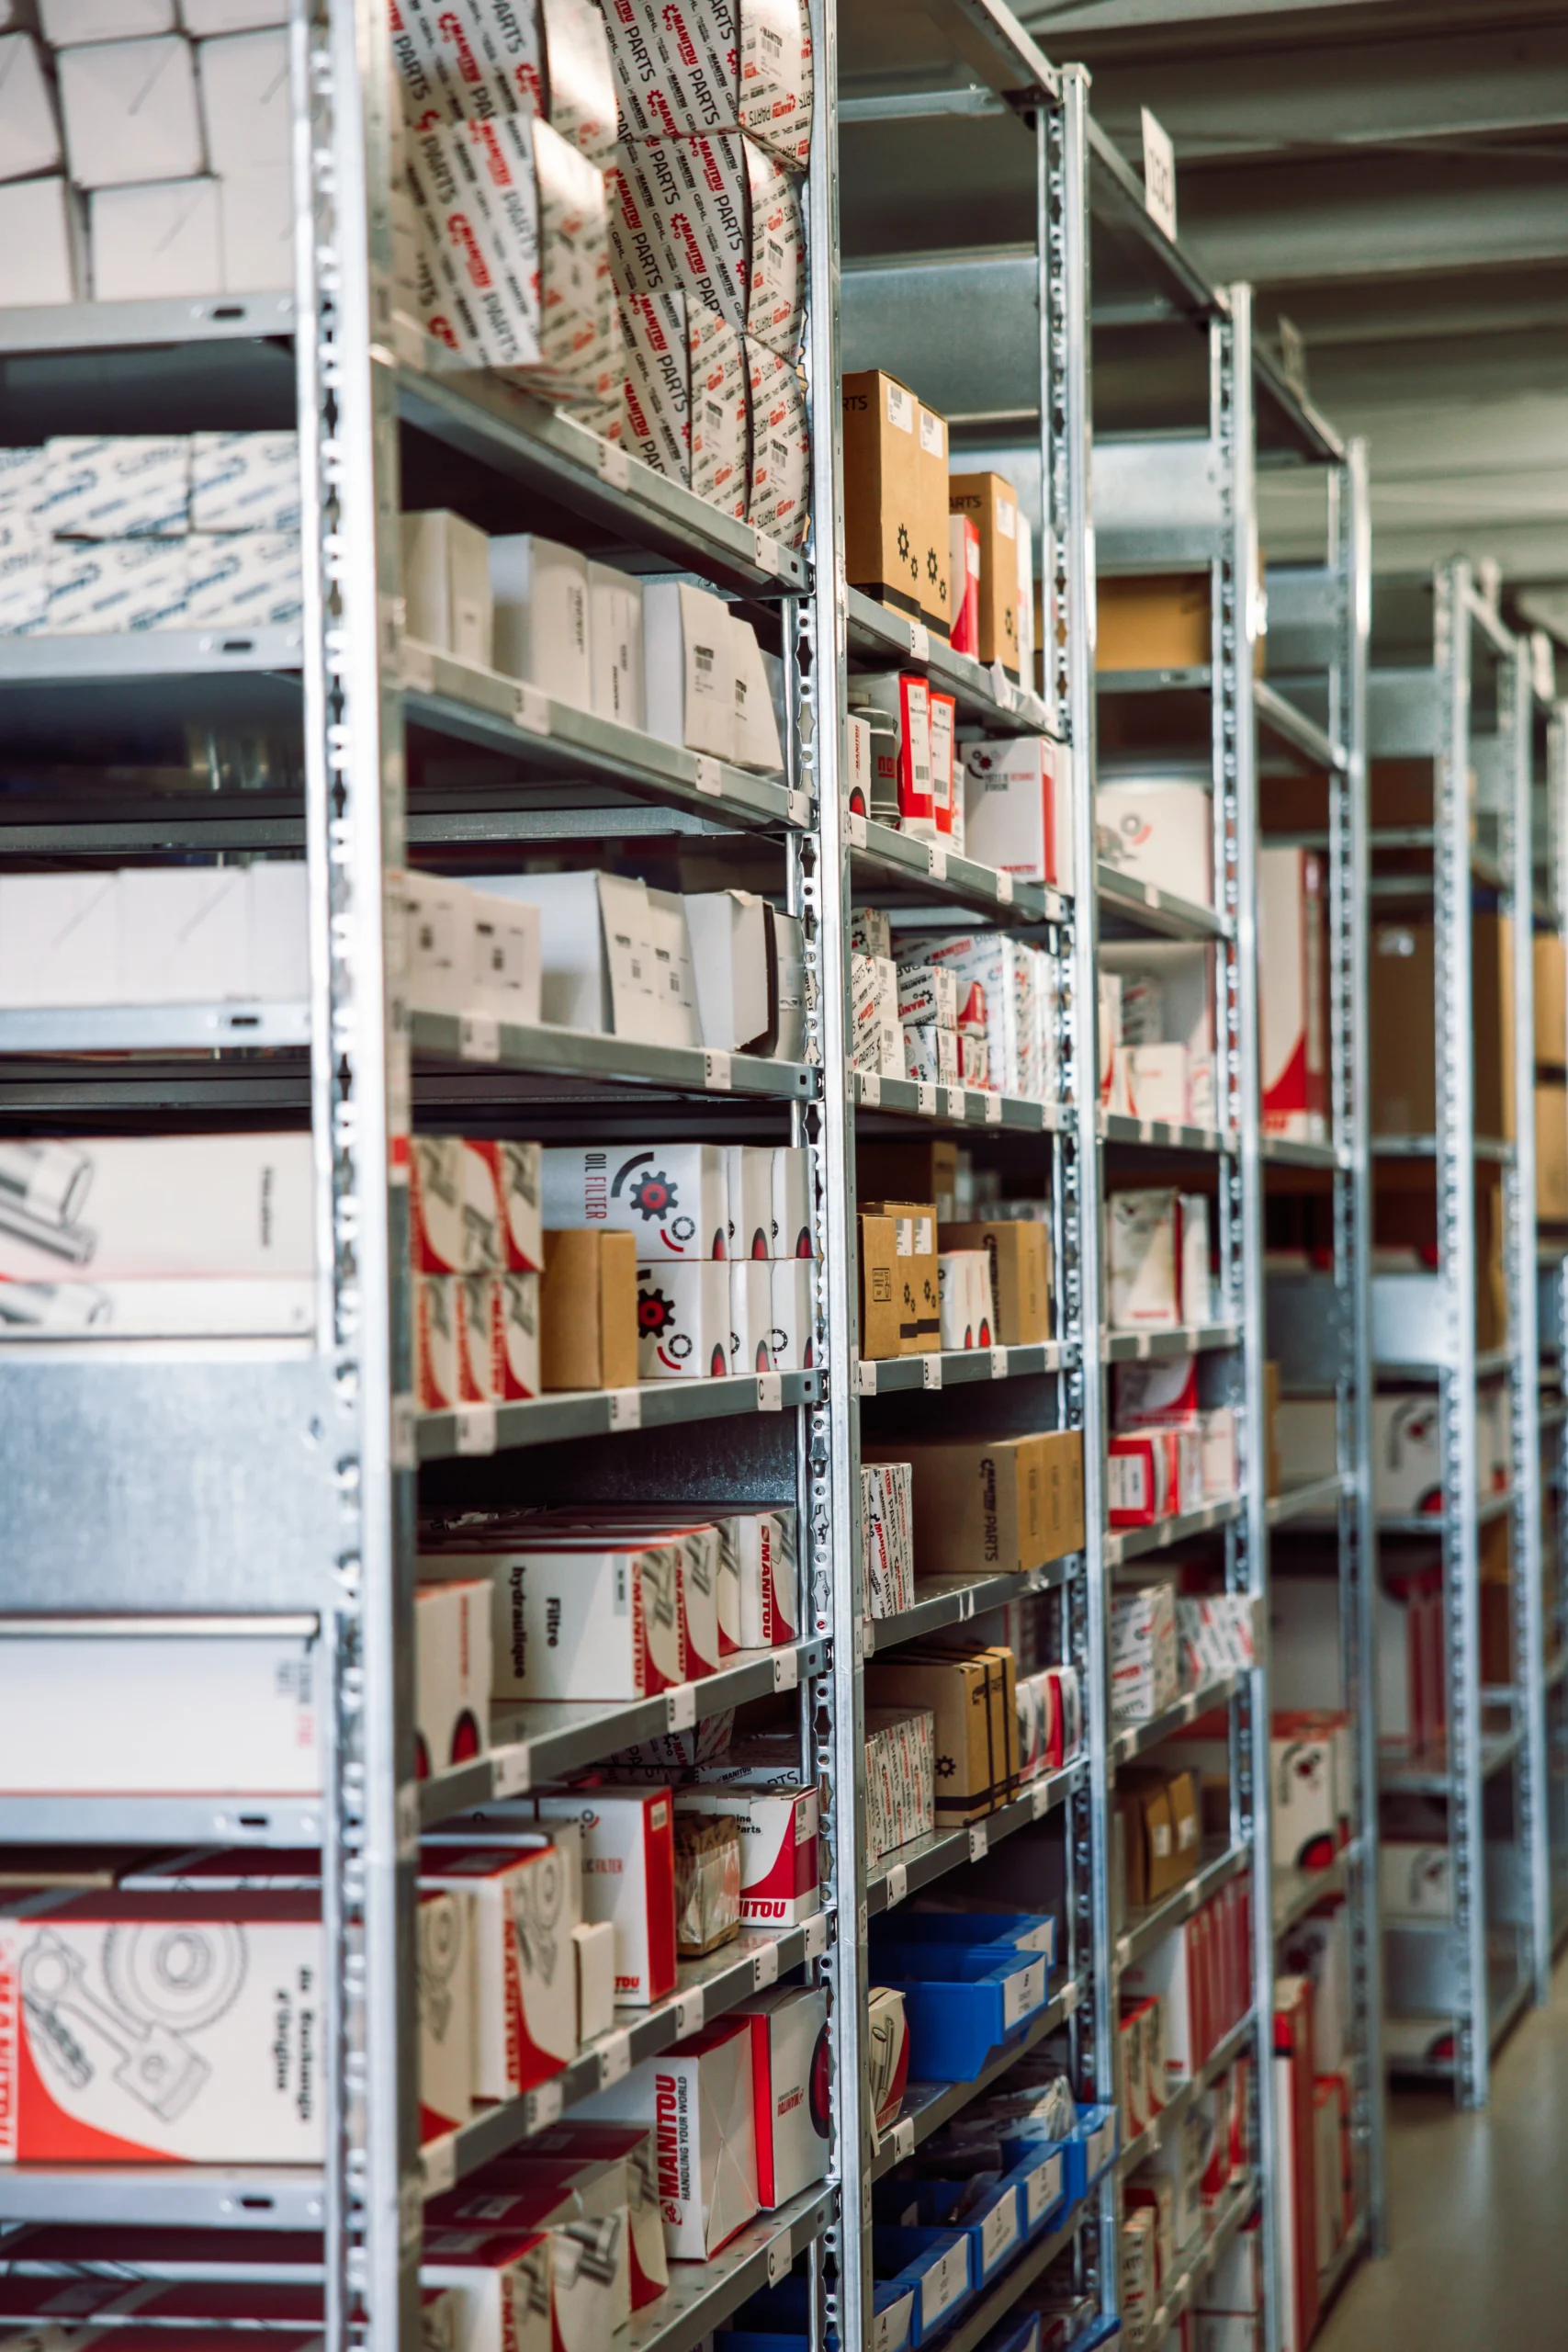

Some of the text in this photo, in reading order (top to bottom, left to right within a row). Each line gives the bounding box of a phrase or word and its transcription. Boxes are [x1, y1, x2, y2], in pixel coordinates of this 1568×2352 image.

[619, 0, 635, 23] ITOU
[710, 0, 736, 40] ARTS
[394, 36, 432, 101] PARTS
[624, 26, 656, 83] PARTS
[644, 5, 659, 34] GEHL
[671, 74, 688, 108] MANITOU
[671, 13, 721, 126] MANITOU GROUP PARTS
[710, 53, 728, 87] MANITOU
[604, 26, 649, 130] GEHL MANITOU
[657, 98, 681, 137] MANIT
[749, 106, 772, 128] PARTS
[721, 135, 738, 170] MANITOU
[638, 173, 667, 242] MANITOU GEHL
[698, 138, 745, 251] MANITOU GROUP PARTS
[616, 178, 643, 230] MANITOU
[631, 232, 663, 289] PARTS
[649, 149, 726, 321] PARTS MANITOU GROUP PART
[679, 154, 696, 188] MANITOU
[694, 193, 708, 222] GEHL
[719, 263, 737, 297] MANITOU
[611, 231, 626, 260] GEHL
[640, 295, 669, 351] MANITOU
[657, 355, 690, 413] PARTS
[623, 382, 650, 437] MANITOU
[842, 395, 868, 412] RTS
[949, 494, 983, 510] ARTS
[756, 535, 761, 558] C
[858, 1041, 875, 1069] PARTS
[862, 1077, 867, 1096] A
[585, 1153, 607, 1219] OIL FILTER
[758, 1379, 764, 1401] C
[888, 1498, 898, 1549] PARTS
[985, 1516, 998, 1562] PARTS
[874, 1522, 887, 1570] MANITOU
[761, 1544, 771, 1638] MANITOU
[509, 1566, 527, 1679] hydraulique
[547, 1597, 561, 1648] Filtre
[632, 1581, 644, 1688] MANITOU
[775, 1660, 781, 1683] C
[722, 1767, 751, 1781] MANITOU
[595, 1858, 623, 1873] FILTER
[739, 1900, 786, 1918] ITOU
[888, 1880, 894, 1901] A
[805, 1928, 810, 1952] F
[755, 1957, 761, 1981] E
[777, 2090, 800, 2117] MANITOU
[656, 2074, 680, 2199] MANITOU
[678, 2075, 691, 2201] HANDLING YOUR WORLD
[896, 2135, 901, 2156] A
[769, 2252, 775, 2277] C
[881, 2316, 886, 2334] A
